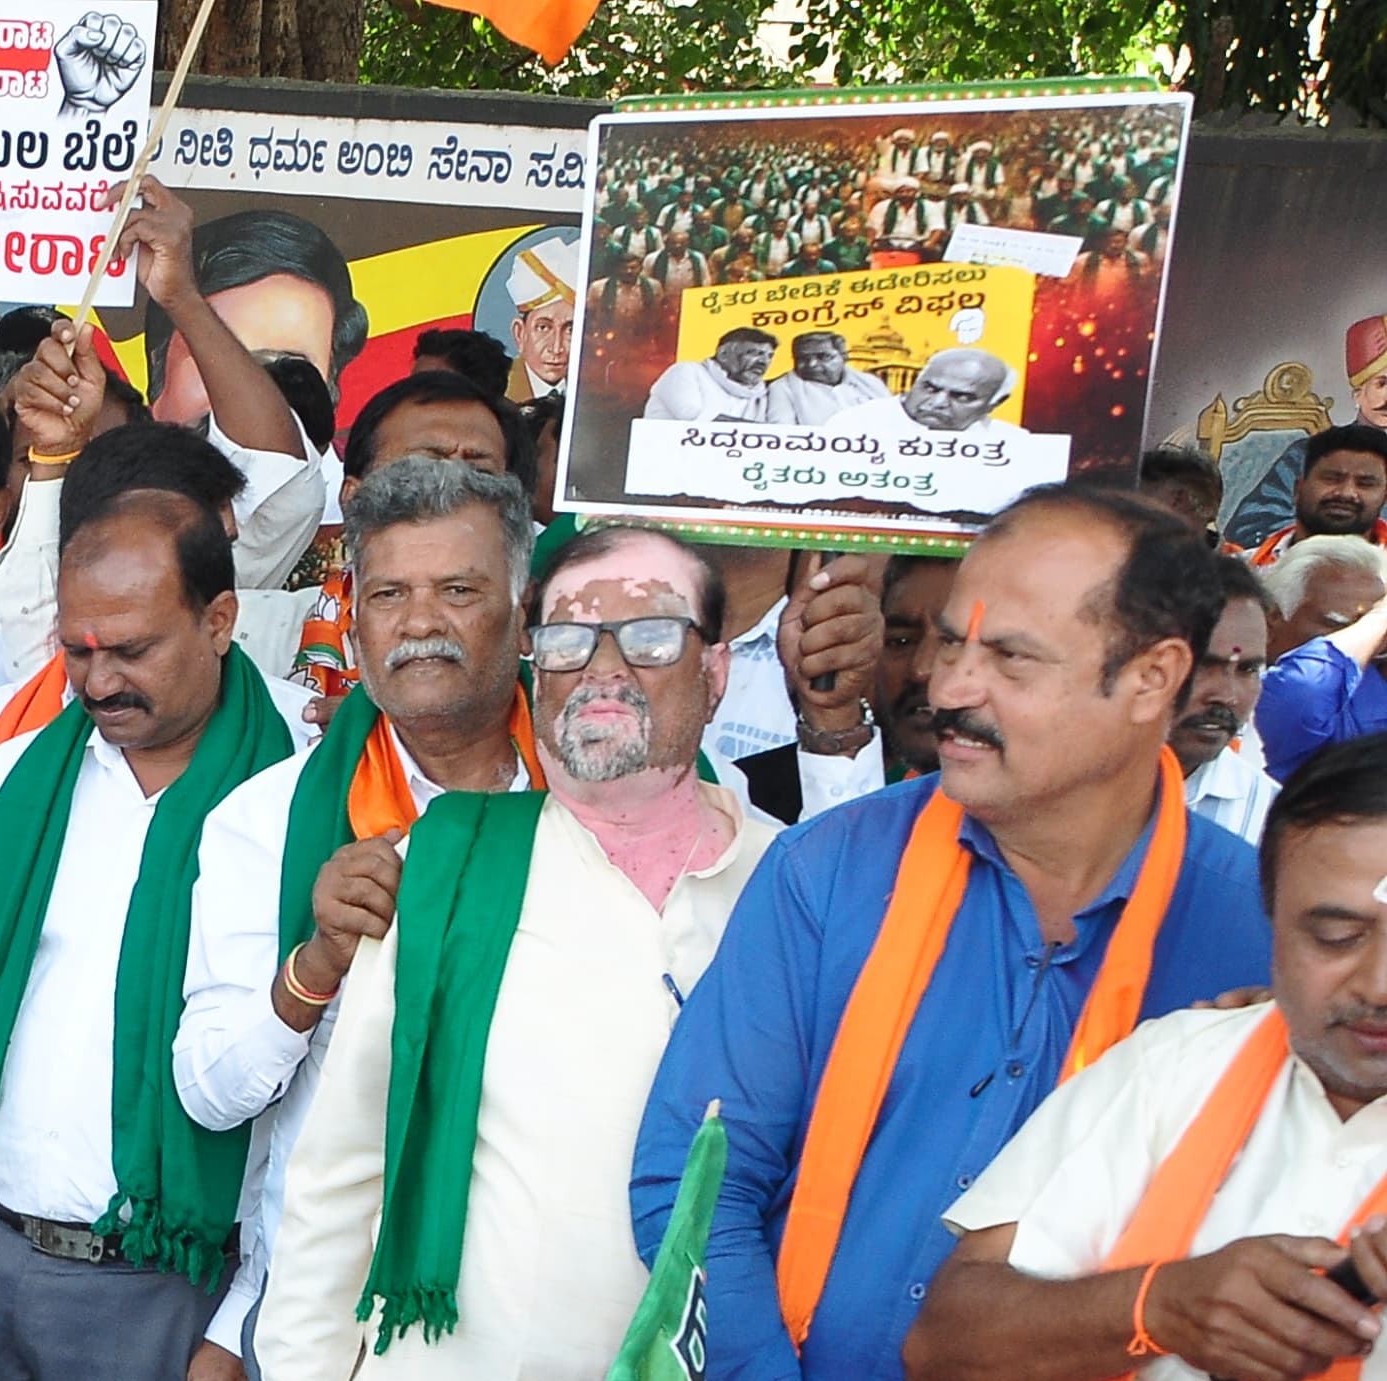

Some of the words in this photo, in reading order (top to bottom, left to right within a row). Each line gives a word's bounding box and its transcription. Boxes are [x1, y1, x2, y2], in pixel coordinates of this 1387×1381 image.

[63, 119, 138, 172] ಬೆಲೆ
[173, 127, 234, 167] ನೀತಿ
[249, 126, 326, 180] ಧರ್ಮ
[337, 142, 413, 176] ಅಂಬಿ
[428, 135, 513, 184] ಸೇನಾ
[701, 288, 757, 312] ರೈತರ
[766, 279, 841, 303] ಬೇಡಿಕೆ
[850, 267, 987, 293] ಈಡೇರಿಸಲು
[751, 297, 885, 327] ಕಾಂಗ್ರೆಸ್
[680, 427, 886, 465] ಸಿದ್ದರಾಮಯ್ಯ
[898, 438, 1011, 467] ಕುತಂತ್ರ
[742, 462, 826, 491] ರೈತರು
[838, 469, 938, 496] ಅತಂತ್ರ
